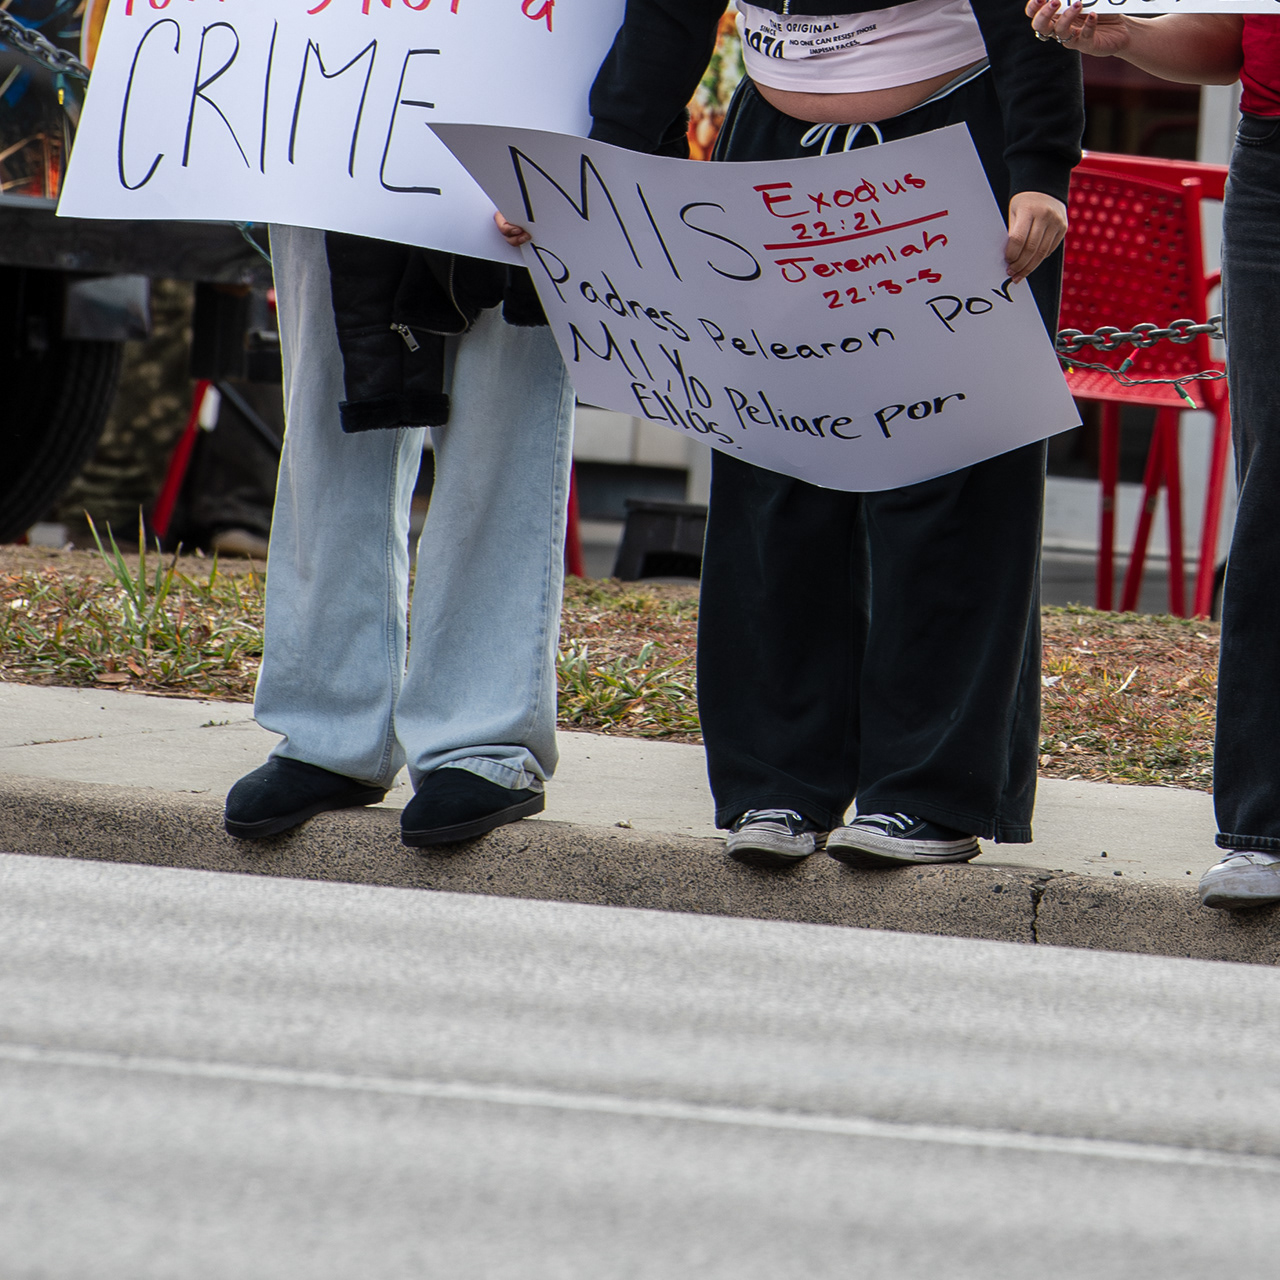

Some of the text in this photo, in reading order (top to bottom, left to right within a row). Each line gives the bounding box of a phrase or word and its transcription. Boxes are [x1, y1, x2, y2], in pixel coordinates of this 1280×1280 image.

[760, 24, 777, 37] SINCE
[786, 22, 840, 34] ORIGINAL
[800, 38, 814, 47] ONE
[815, 37, 832, 46] CAN
[833, 31, 856, 43] RESIST
[856, 23, 878, 36] THOSE
[117, 18, 442, 196] CRIME
[507, 145, 762, 282] MIS
[752, 173, 927, 219] Exodus
[791, 208, 882, 240] 22:21
[530, 241, 691, 343] Padres
[697, 317, 895, 360] Pelearon
[723, 385, 863, 440] Peliare
